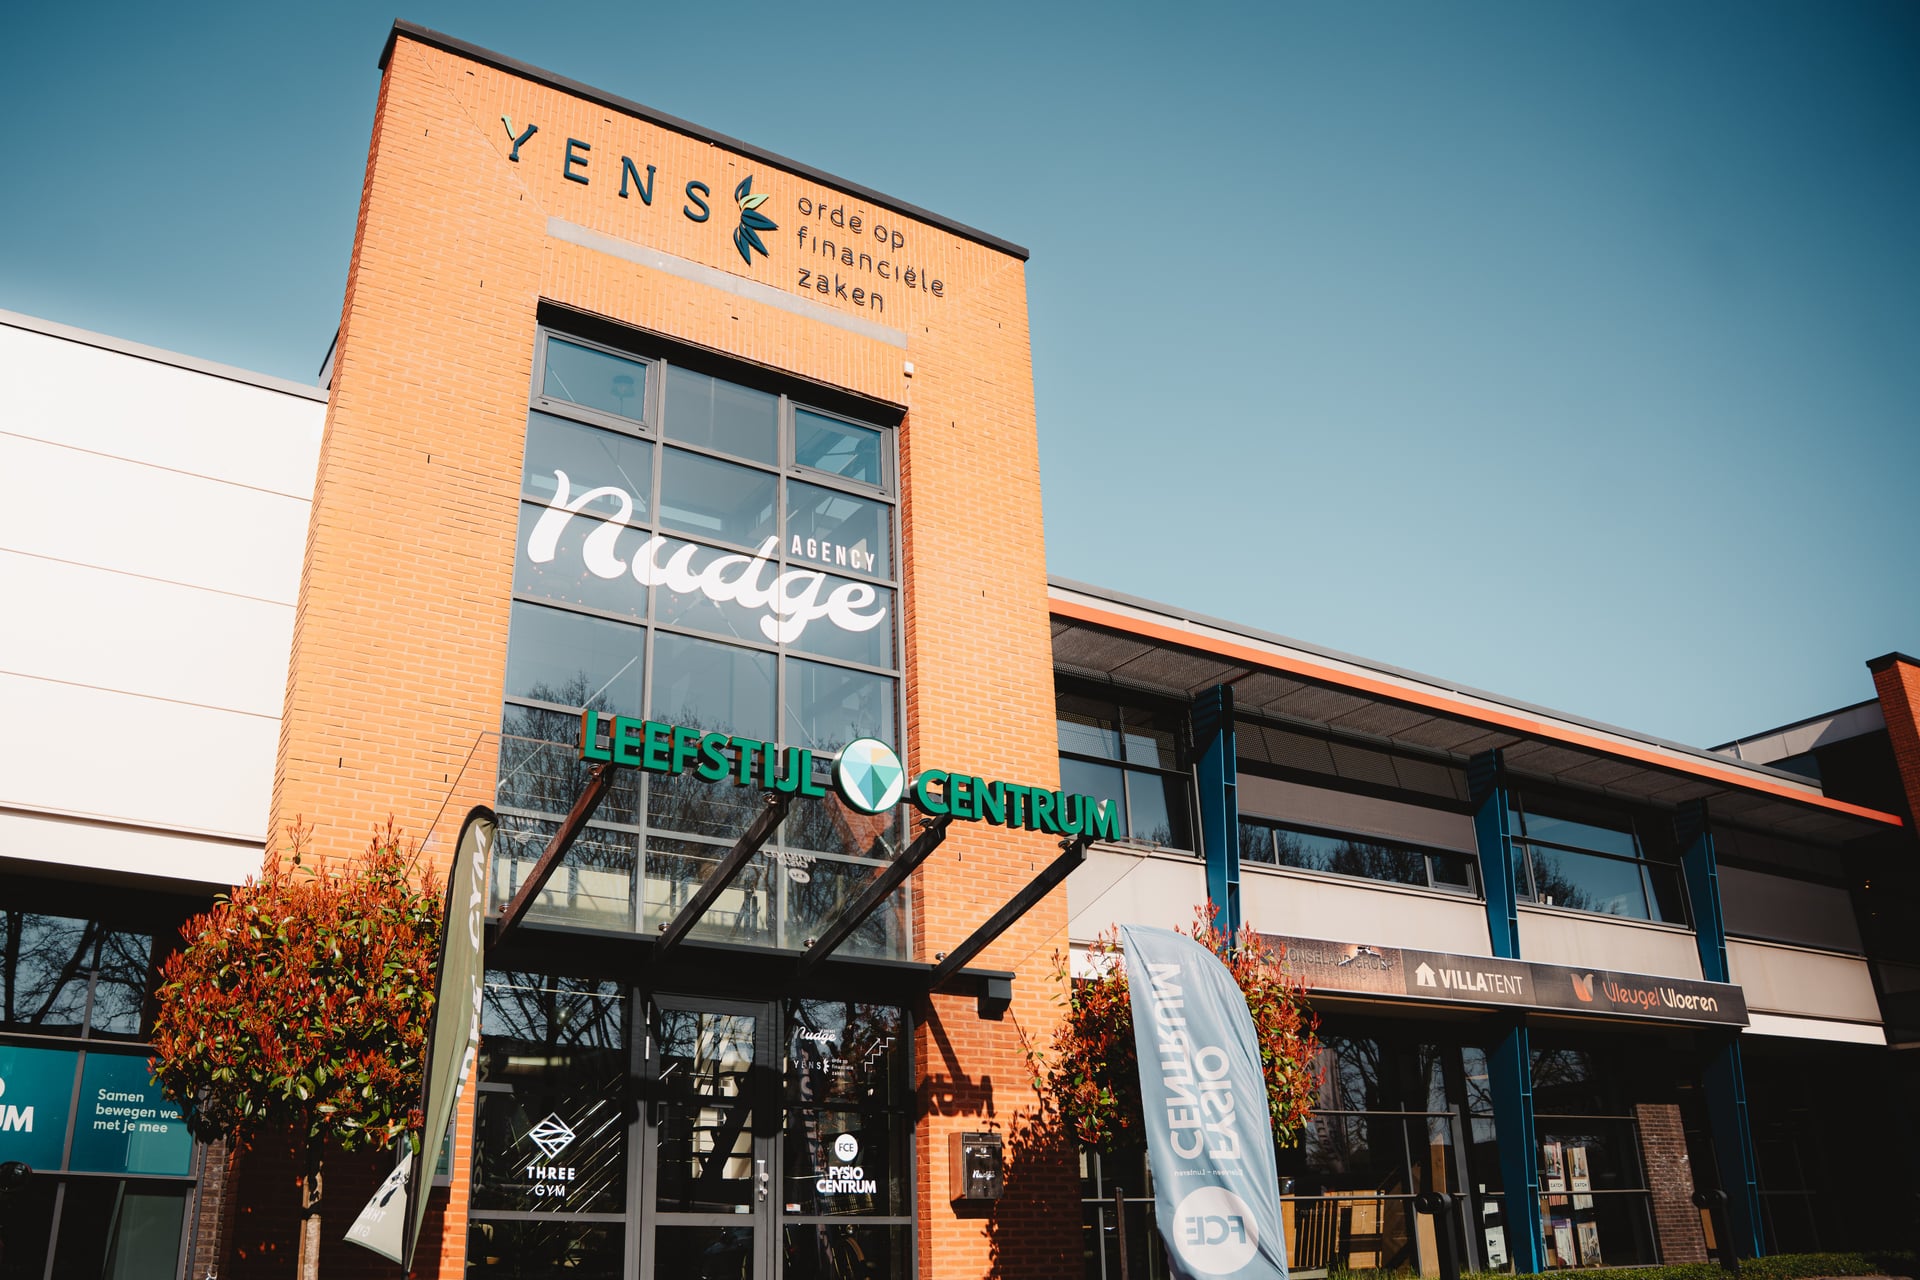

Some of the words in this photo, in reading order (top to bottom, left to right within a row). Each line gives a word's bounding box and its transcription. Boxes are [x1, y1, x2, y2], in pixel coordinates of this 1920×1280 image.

[501, 114, 710, 222] YENS
[798, 196, 862, 234] orde
[874, 224, 905, 252] op
[796, 226, 945, 298] financiële
[797, 267, 884, 313] zaken
[791, 535, 875, 573] AGENCY
[579, 709, 826, 799] LEEFSTIJL
[912, 769, 1121, 842] CENTRUM
[1660, 987, 1718, 1013] Vloeren
[98, 1088, 144, 1103] Samen
[96, 1103, 157, 1120] bewegen
[160, 1109, 178, 1119] we
[93, 1119, 120, 1131] met
[122, 1120, 136, 1134] je
[139, 1122, 168, 1133] mee
[838, 1143, 855, 1153] FCE
[526, 1166, 576, 1180] THREE
[829, 1166, 864, 1180] FYSIO
[534, 1184, 566, 1197] GYM
[816, 1180, 877, 1193] CENTRUM
